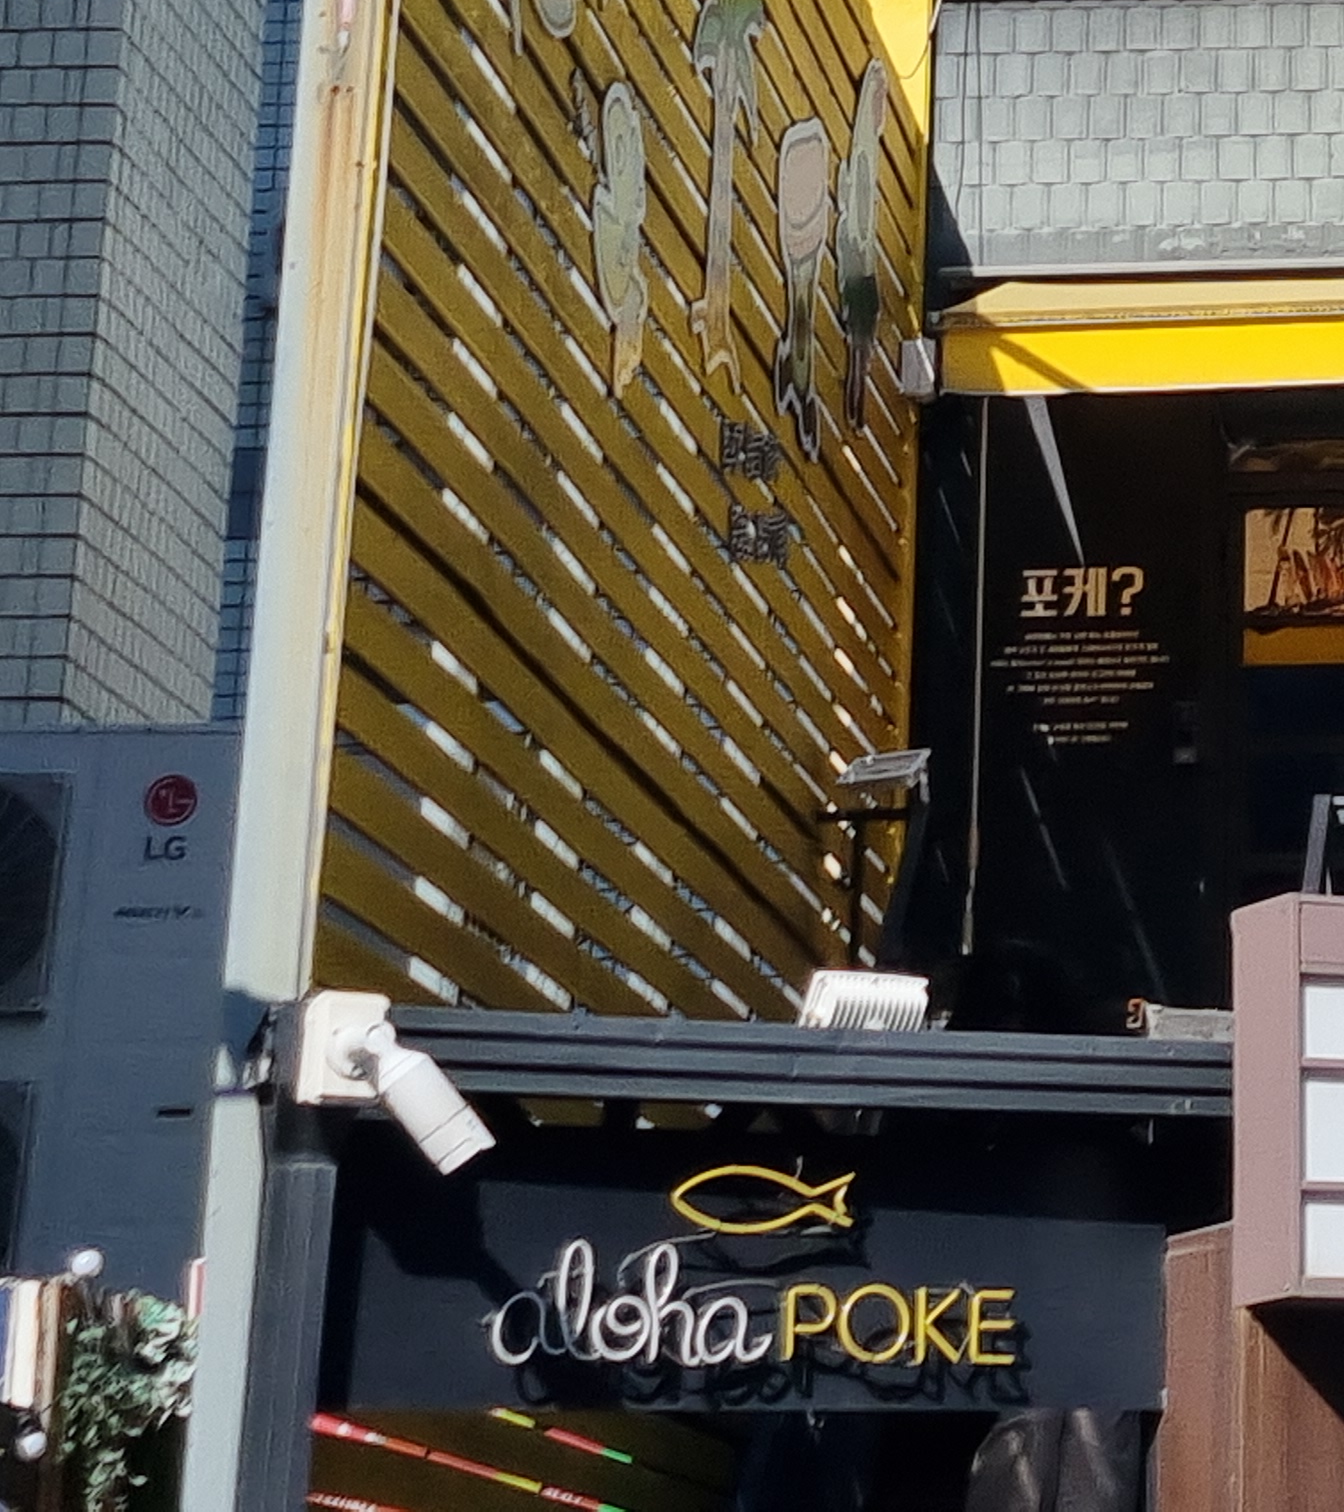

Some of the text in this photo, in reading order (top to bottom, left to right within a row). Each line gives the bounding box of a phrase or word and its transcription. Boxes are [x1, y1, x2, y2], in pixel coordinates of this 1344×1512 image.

[1020, 566, 1144, 617] 포케?
[143, 836, 187, 860] LG
[490, 1238, 1017, 1366] aloha POKE
